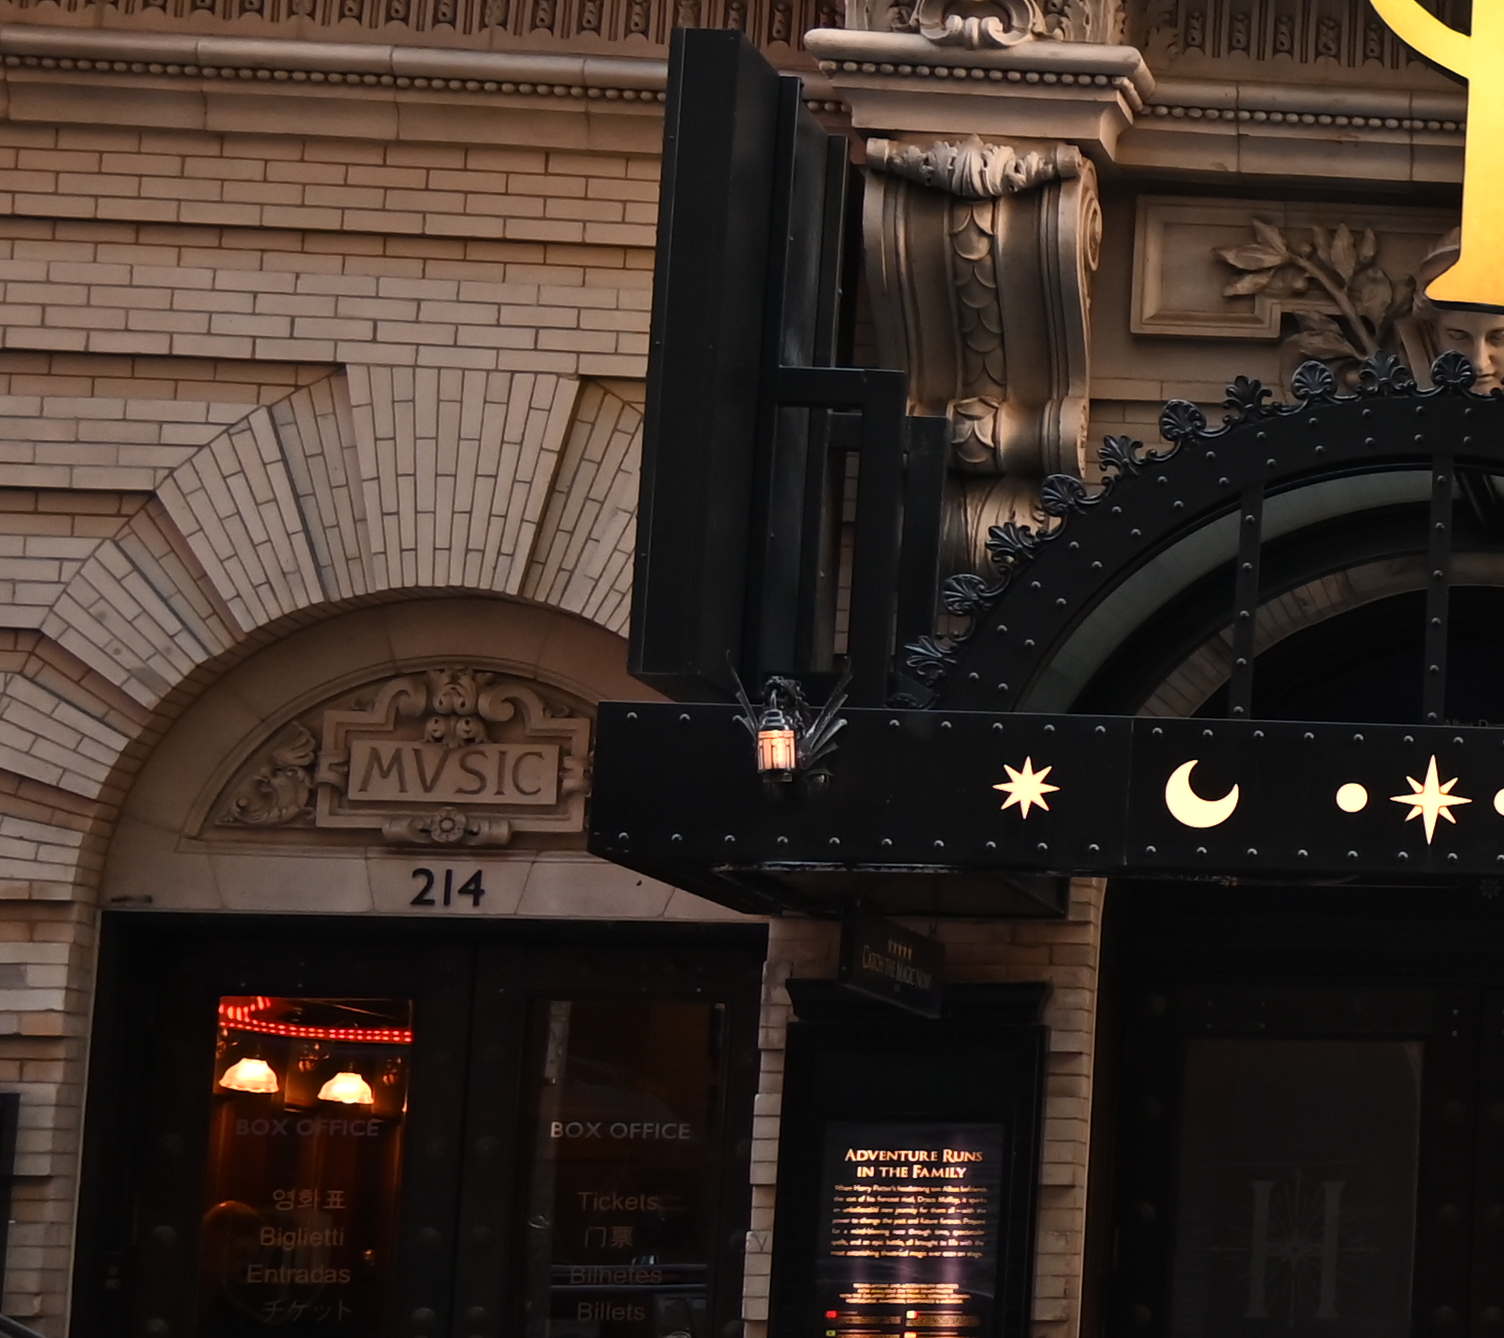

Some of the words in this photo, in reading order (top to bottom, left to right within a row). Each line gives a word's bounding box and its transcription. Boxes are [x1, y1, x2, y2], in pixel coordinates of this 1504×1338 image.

[358, 747, 545, 796] MVSIC
[410, 867, 486, 907] 214
[236, 1118, 288, 1136] BOX
[296, 1118, 380, 1137] OFFICE
[549, 1120, 602, 1139] BOX
[609, 1121, 691, 1140] OFFICE
[844, 1148, 938, 1163] ADVENTURE
[942, 1148, 984, 1163] RUNS
[856, 1165, 875, 1178] IN
[879, 1166, 909, 1178] THE
[912, 1164, 968, 1179] FAMILY
[272, 1188, 346, 1211] 영화표
[577, 1191, 661, 1211] Tickets
[259, 1226, 344, 1251] Biglietti
[584, 1225, 634, 1248] 门票
[246, 1263, 352, 1283] Entradas
[262, 1299, 352, 1321] チケット
[577, 1301, 646, 1322] Billets
